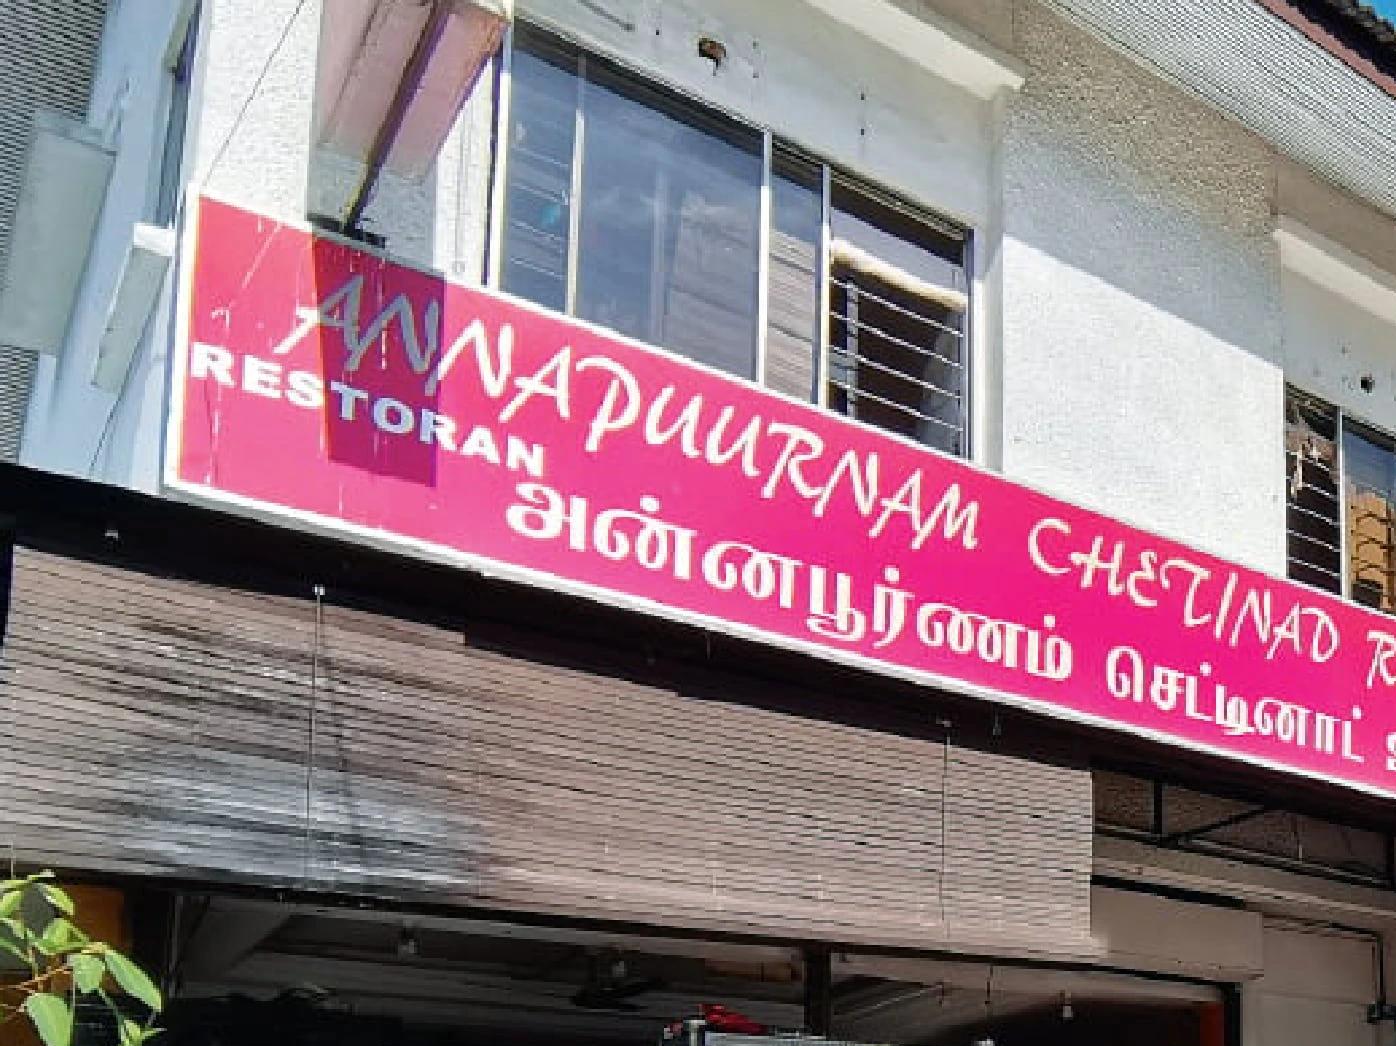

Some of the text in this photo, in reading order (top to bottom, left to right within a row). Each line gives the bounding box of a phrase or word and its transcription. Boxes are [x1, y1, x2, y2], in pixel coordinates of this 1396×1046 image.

[190, 341, 545, 478] RESTORAN
[274, 272, 981, 552] ANNAPUURNAM
[1027, 517, 1341, 664] CHETINAD
[505, 482, 1073, 682] அன்னபூர்ணம்
[1105, 646, 1365, 763] செட்டினாட்
